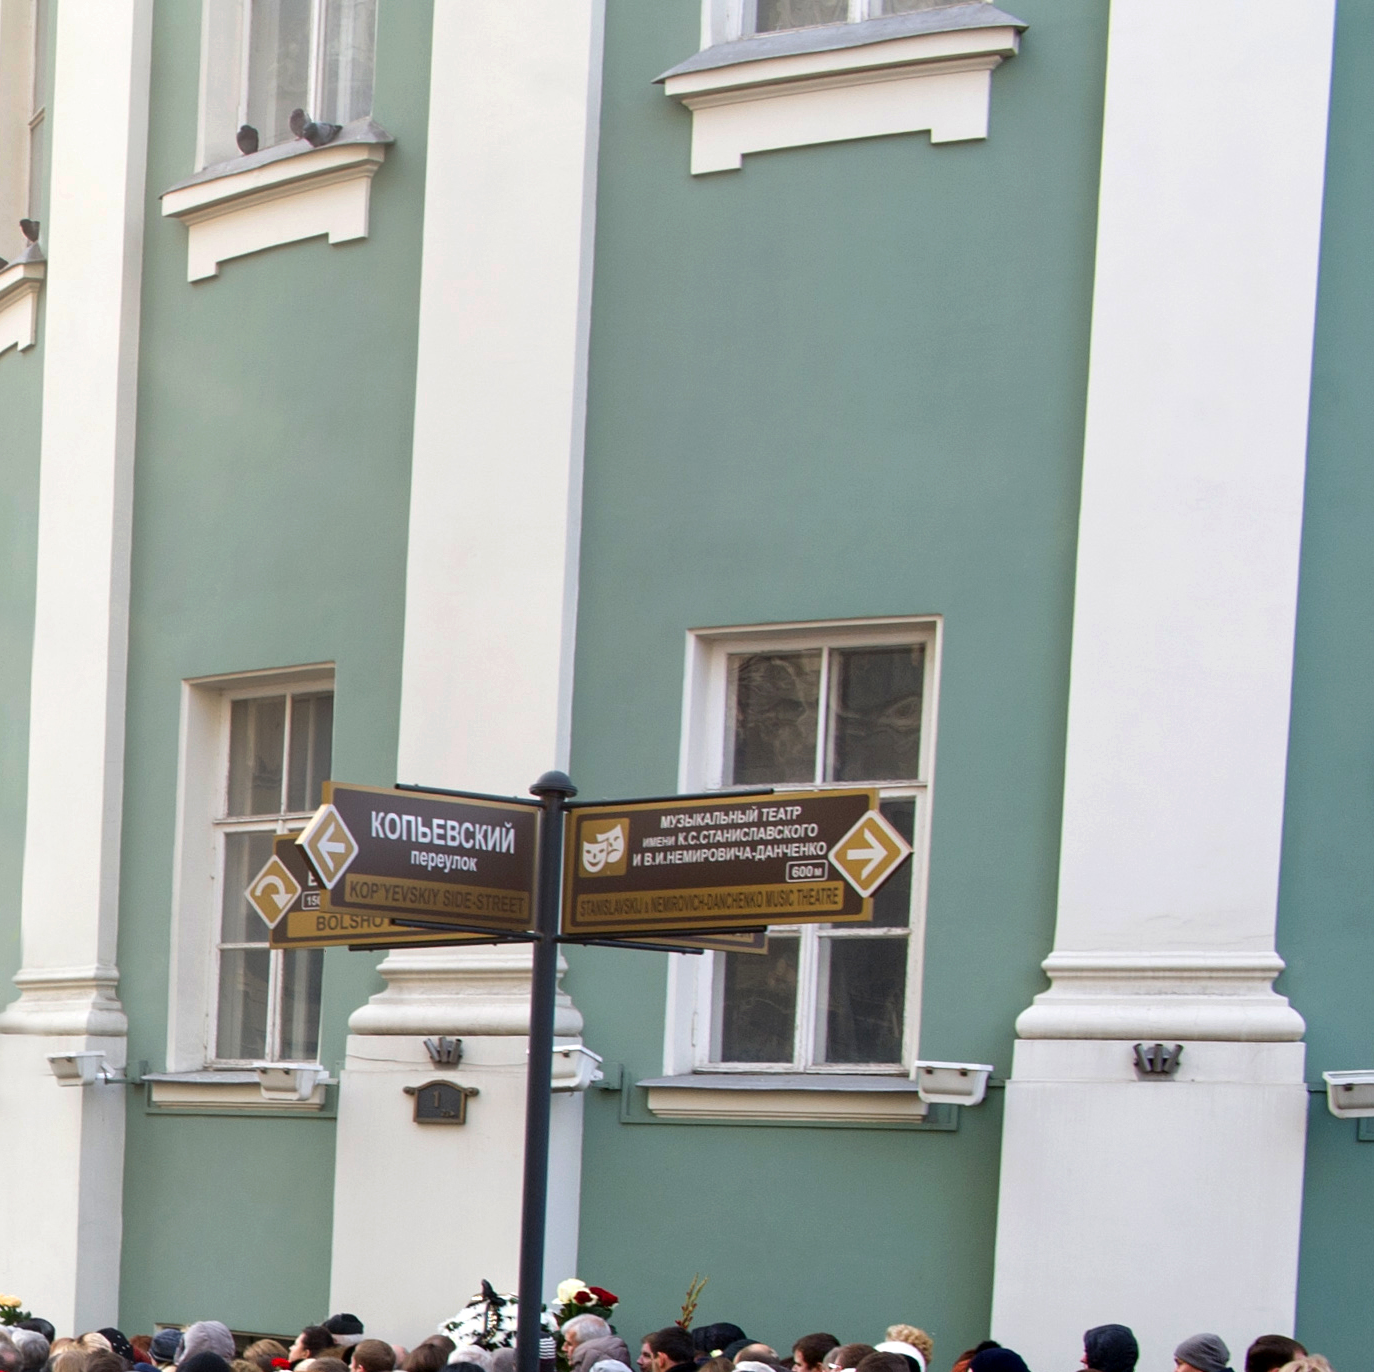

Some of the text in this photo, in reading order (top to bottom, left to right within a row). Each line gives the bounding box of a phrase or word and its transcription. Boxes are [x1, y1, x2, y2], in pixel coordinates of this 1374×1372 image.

[660, 806, 802, 829] МУЗЫКАЛЬНЫЙ ТЕАТР
[371, 811, 516, 854] КОПЬЕВСКИЙ
[642, 823, 818, 848] ИМЕНИ К.С.СТАНИСЛАВСКОГО
[411, 850, 479, 873] переулок
[632, 842, 827, 867] И В.И.НЕМИРОВИЧА-ДАНЧЕНКО
[349, 880, 525, 914] KOP'YEVSKIY SIDE-STREET
[651, 890, 763, 914] NEMIROVICH-DANCHENKO
[765, 888, 794, 908] MUSIC
[796, 886, 840, 907] THEATRE
[315, 914, 393, 932] BOLSHO
